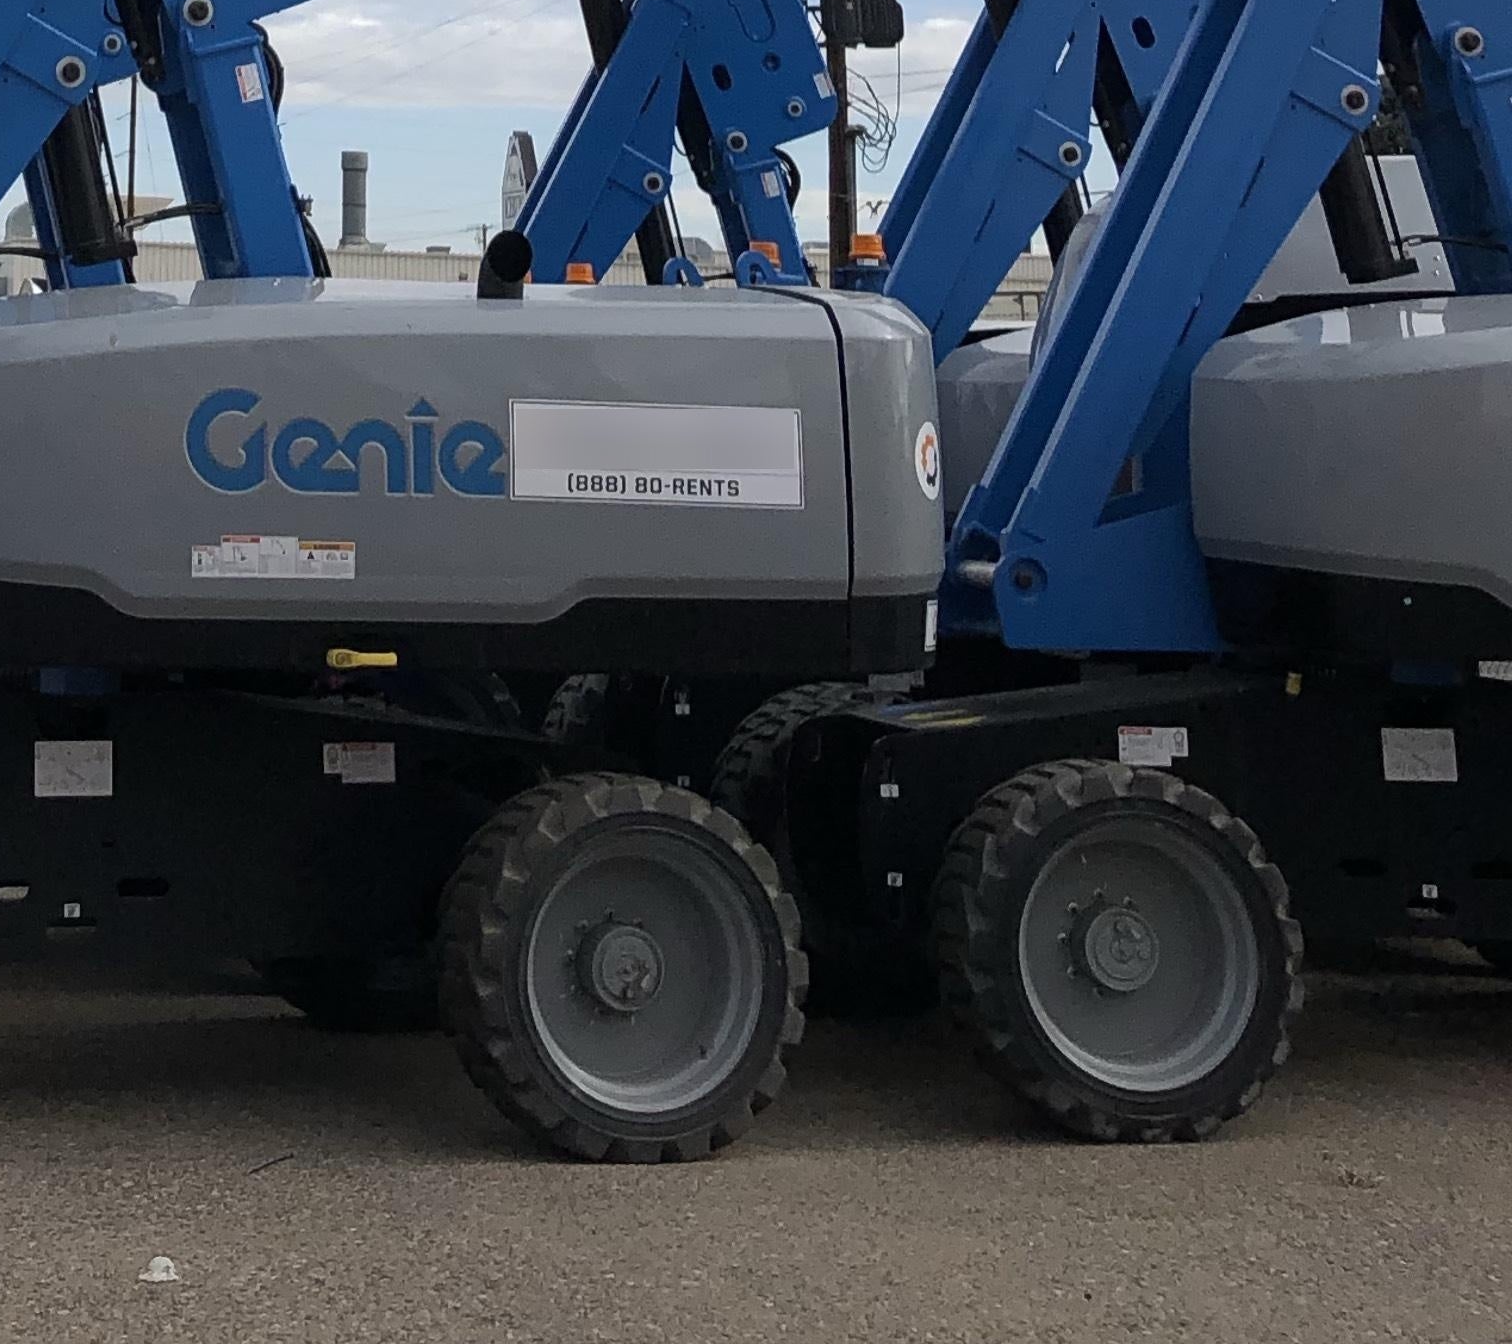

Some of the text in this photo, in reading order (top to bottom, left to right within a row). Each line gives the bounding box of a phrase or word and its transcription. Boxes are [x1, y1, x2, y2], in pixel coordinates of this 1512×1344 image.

[185, 388, 505, 497] Genie
[568, 473, 740, 497] (888) 80-RENTS
